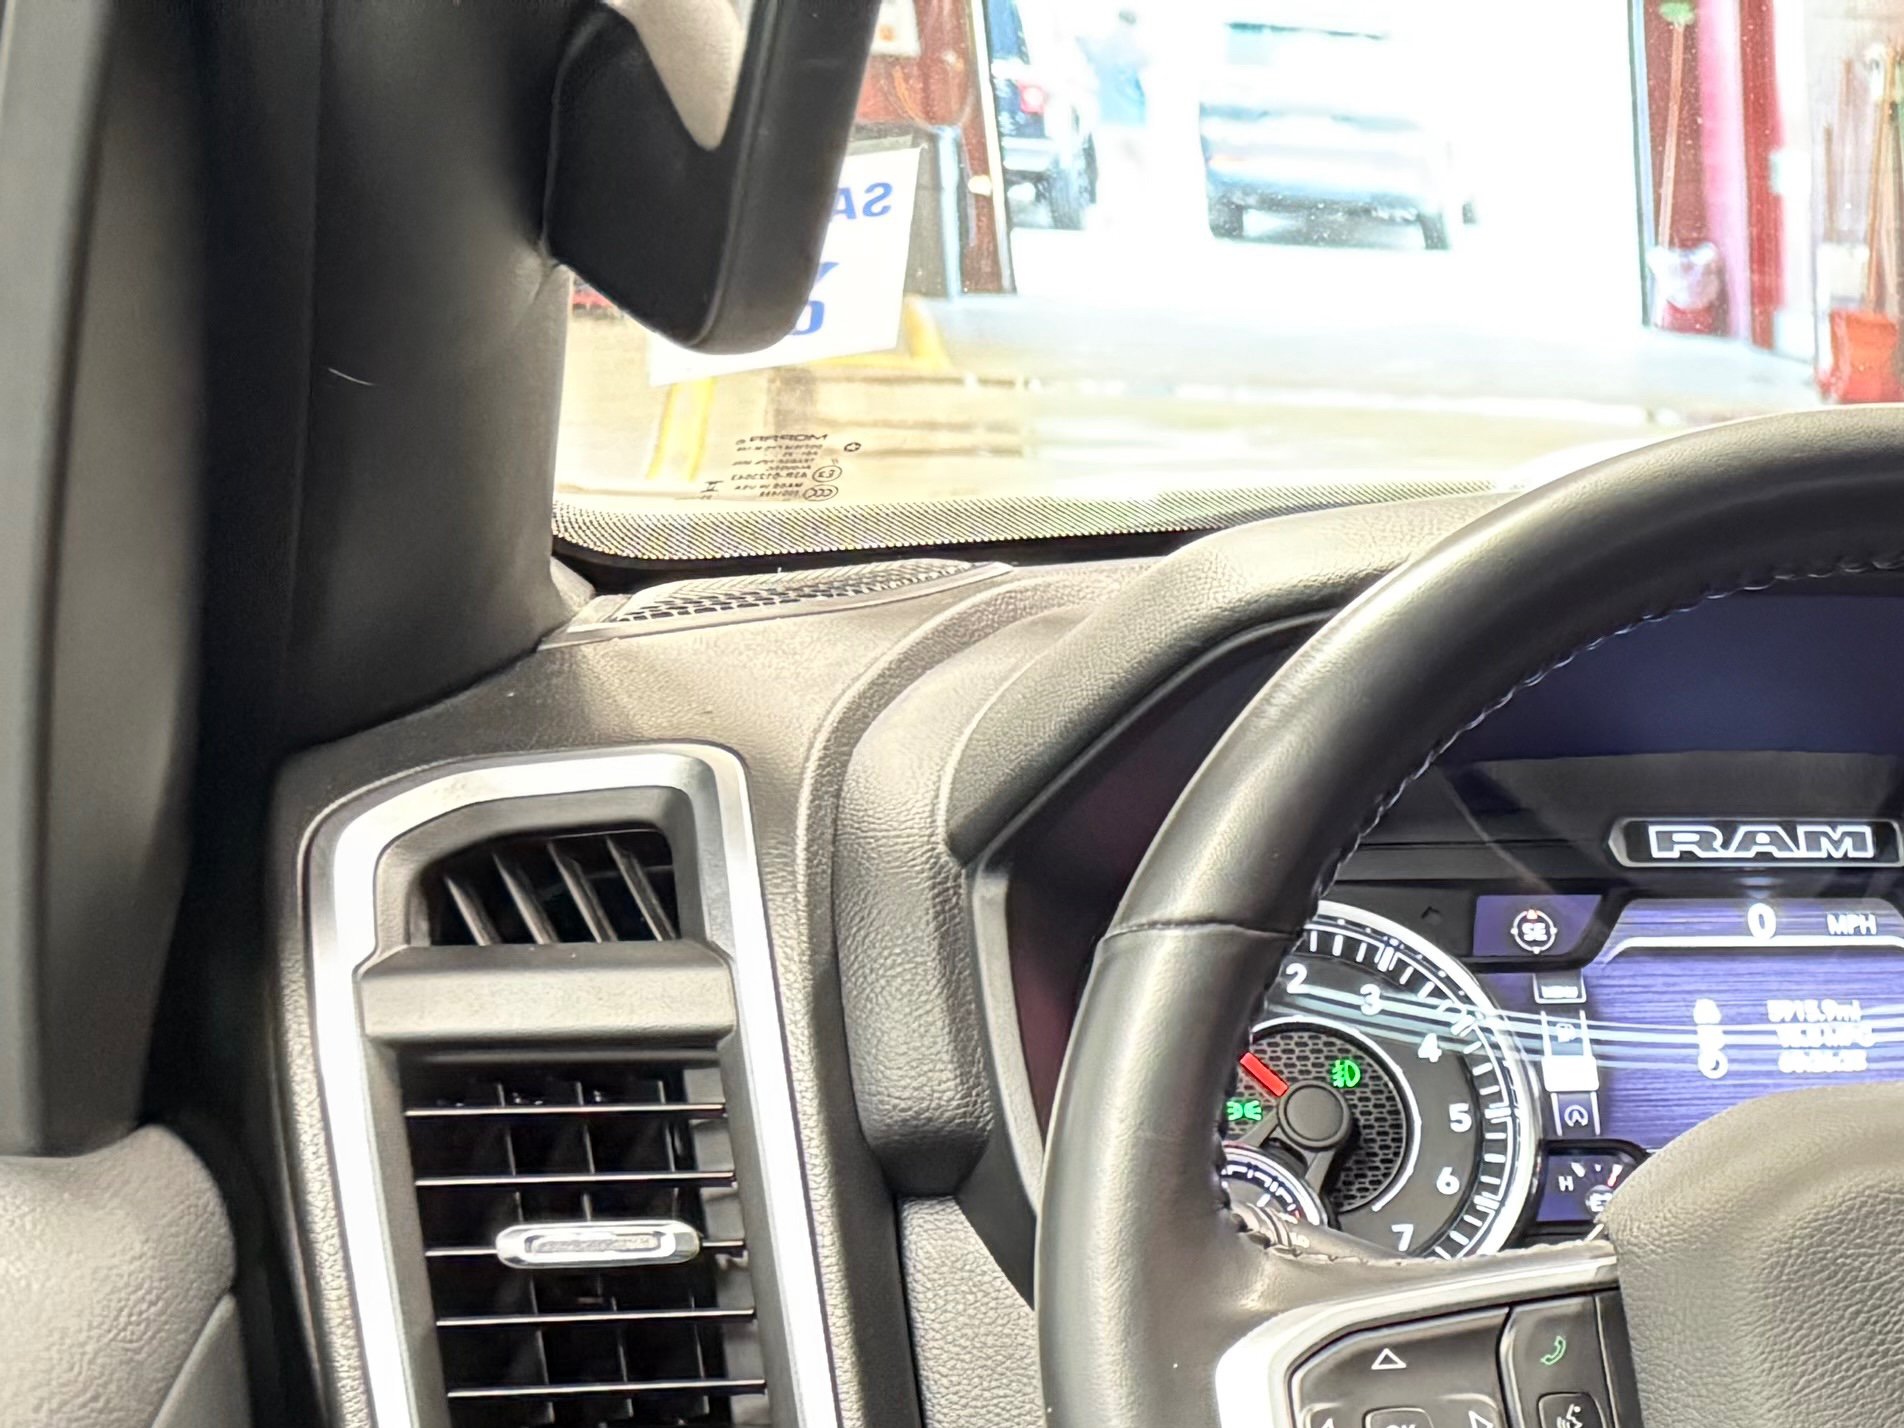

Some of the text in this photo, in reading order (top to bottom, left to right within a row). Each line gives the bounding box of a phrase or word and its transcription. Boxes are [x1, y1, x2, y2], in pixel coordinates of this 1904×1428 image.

[1648, 825, 1876, 859] RAM
[1747, 903, 1877, 941] 0 MPH
[1285, 963, 1308, 994] 2
[1360, 984, 1382, 1016] 3
[1418, 1033, 1442, 1063] 4
[1449, 1103, 1473, 1133] 5
[1436, 1166, 1460, 1195] 6
[1392, 1224, 1415, 1252] 7
